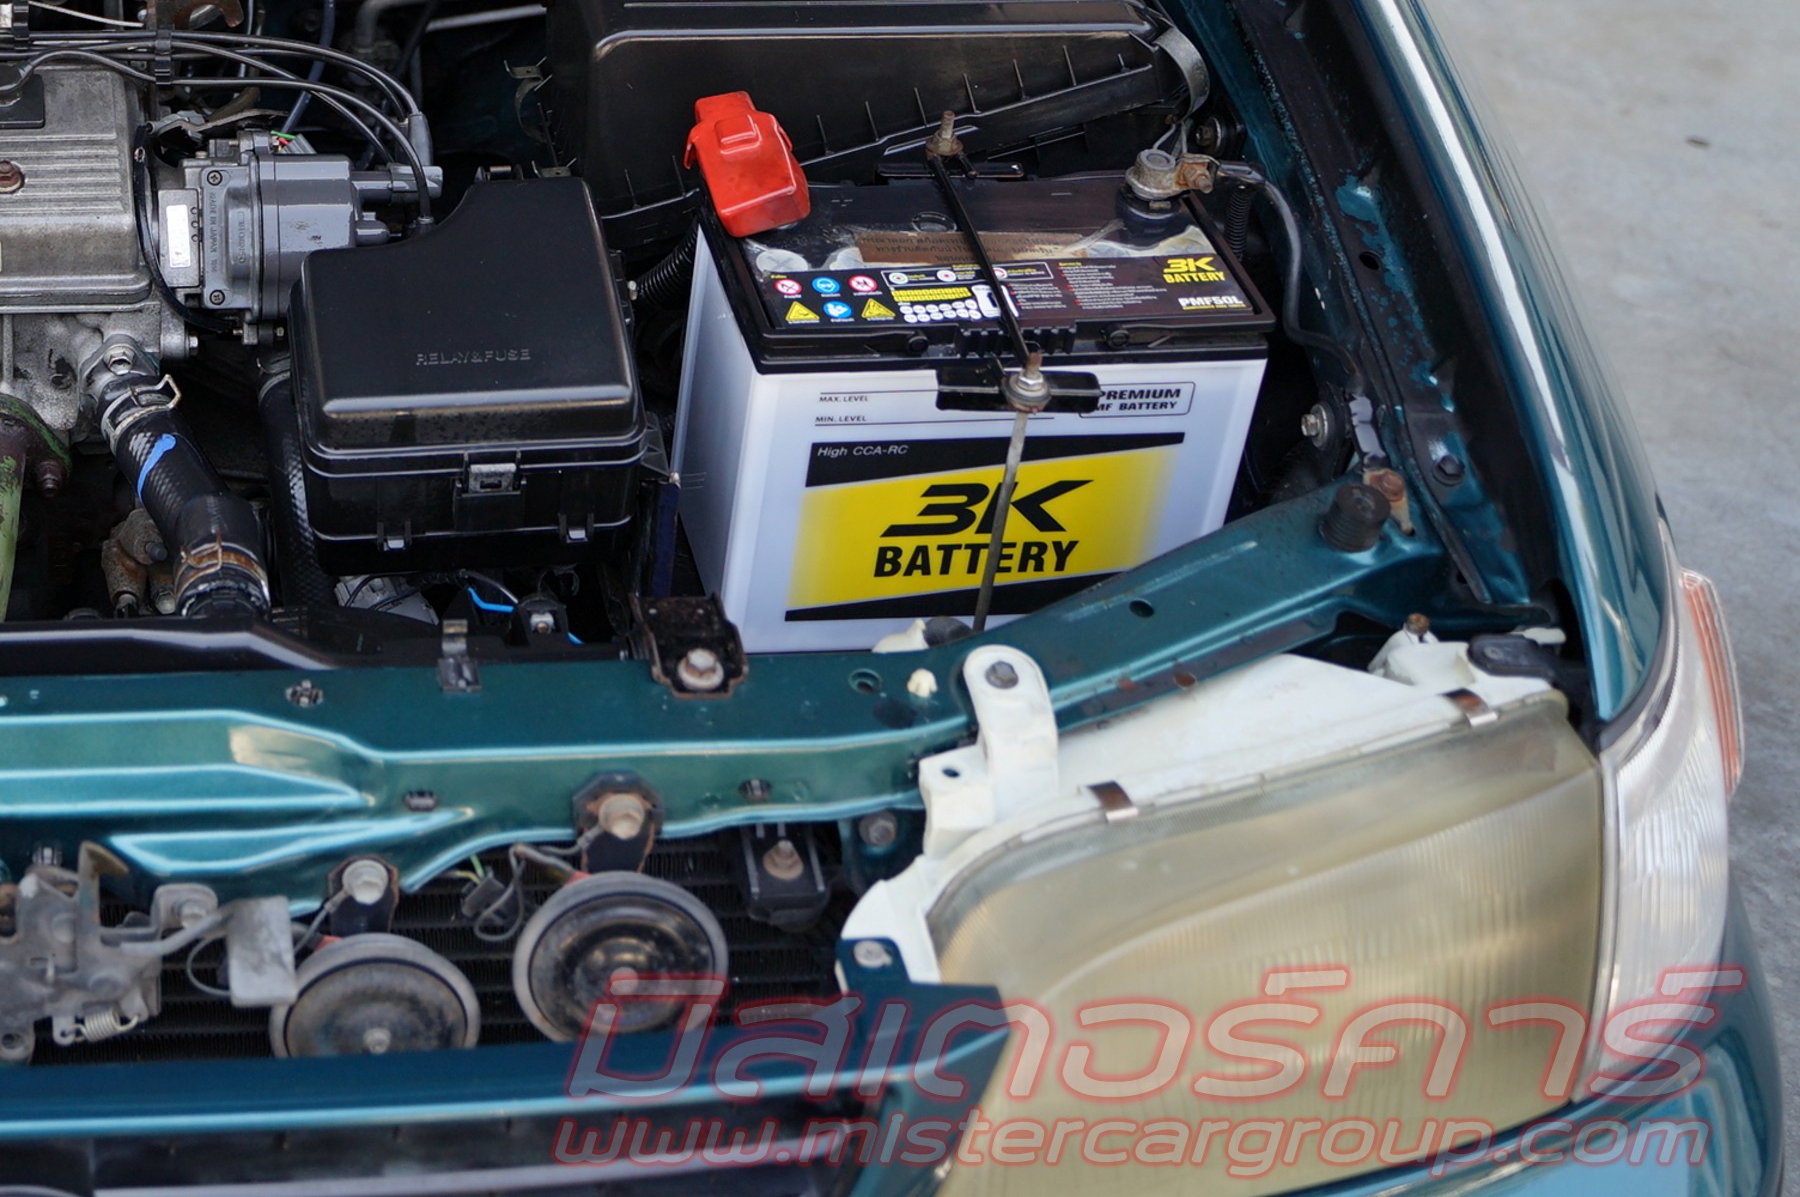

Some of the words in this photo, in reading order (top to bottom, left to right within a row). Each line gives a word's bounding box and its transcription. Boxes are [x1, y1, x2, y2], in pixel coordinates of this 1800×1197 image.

[1163, 256, 1217, 273] 3K
[1163, 271, 1226, 284] BATTERY
[843, 395, 869, 403] LEVEL
[1119, 401, 1177, 411] BATTERY
[817, 446, 848, 458] High
[852, 444, 909, 456] CCA-RC
[879, 479, 1095, 538] 3K
[873, 539, 1080, 578] BATTERY
